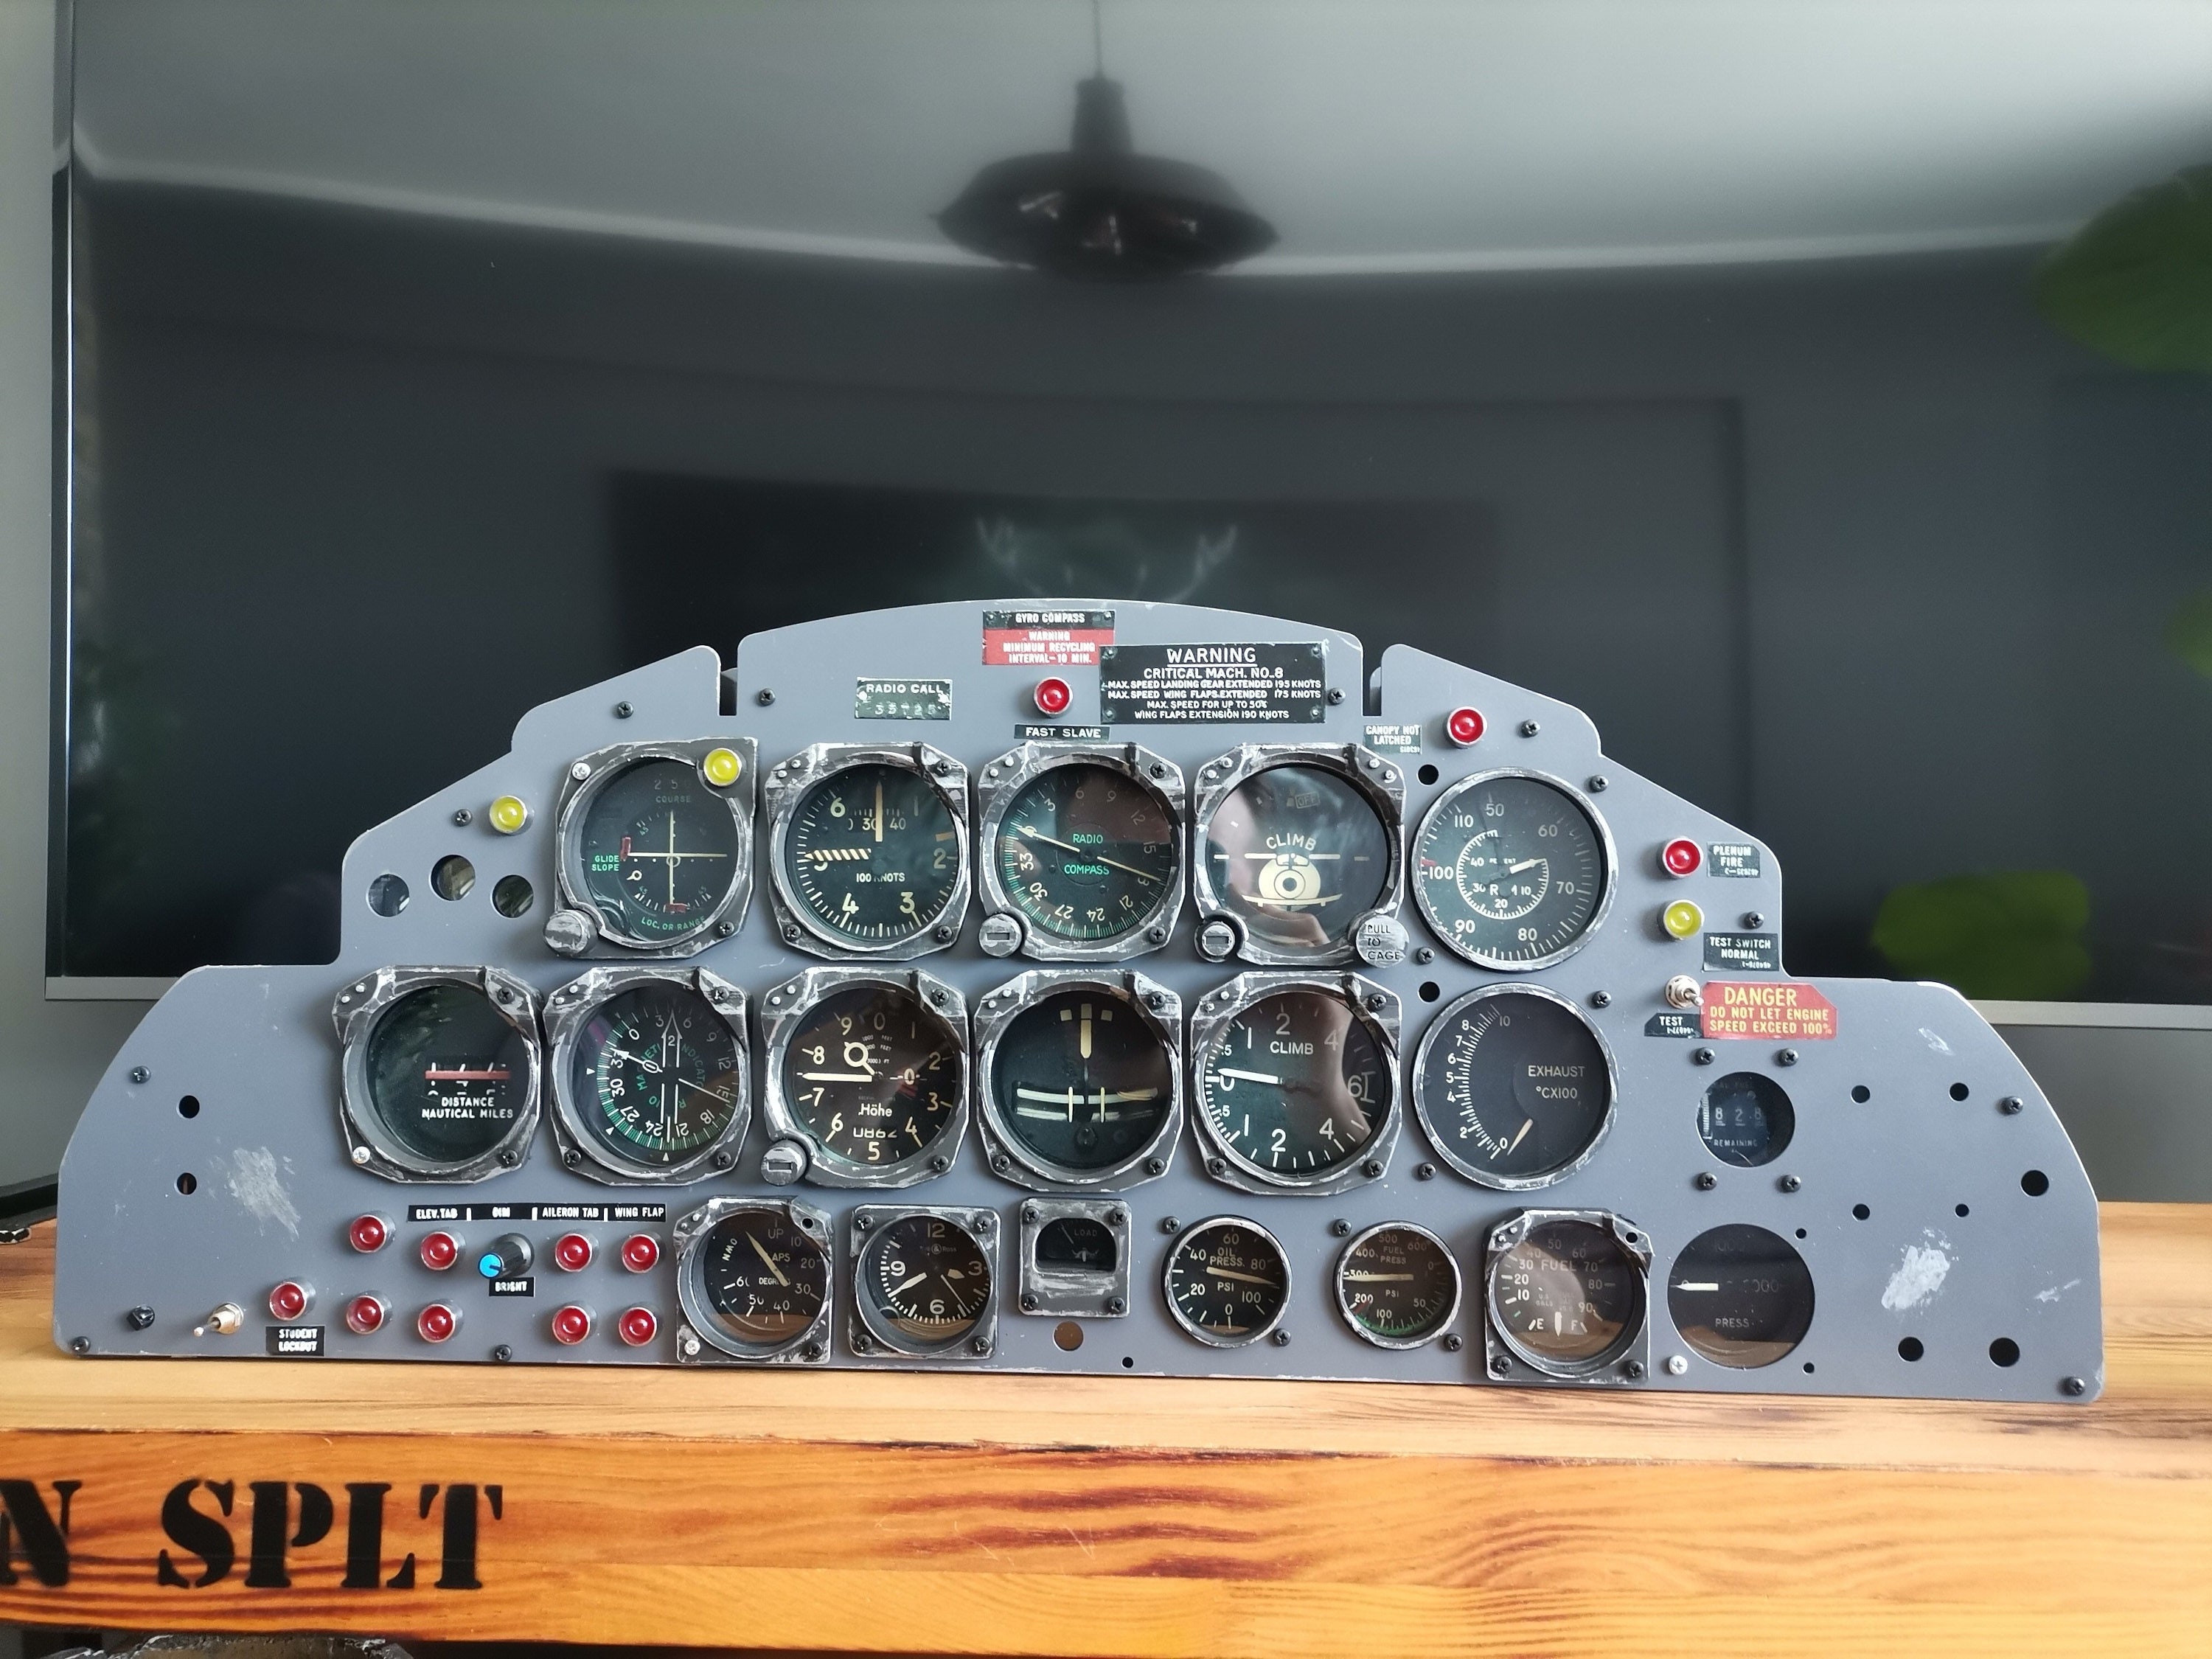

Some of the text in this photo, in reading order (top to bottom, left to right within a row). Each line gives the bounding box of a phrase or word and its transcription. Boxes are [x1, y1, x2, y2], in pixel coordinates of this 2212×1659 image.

[1015, 612, 1085, 623] GYRO COMPASS
[1029, 631, 1070, 641] WARNING
[1004, 642, 1095, 652] MINIMUM RECYCLING
[1071, 653, 1092, 663] MIN.
[1166, 647, 1256, 663] WARNING
[1144, 668, 1247, 678] CRITICAL MACH.
[866, 684, 943, 694] RADIO CALL
[1107, 679, 1321, 689] MAX. SPEED LANDING GEAR EXTENDED 195 KNOTS
[1107, 691, 1130, 699] MAX.
[1164, 690, 1186, 698] WING
[1274, 689, 1289, 698] 175
[1171, 700, 1199, 709] SPEED
[1135, 710, 1158, 718] WING
[1189, 709, 1239, 718] EXTENSION
[1259, 711, 1289, 719] KNOTS
[1026, 727, 1102, 737] FAST SLAVE
[1366, 725, 1419, 735] CANOPY NOT
[1374, 735, 1411, 745] LATCHED
[830, 797, 846, 818] 6
[1486, 804, 1504, 816] 50
[890, 818, 906, 830] 40
[1454, 815, 1473, 828] 110
[1538, 824, 1557, 837] 60
[1073, 833, 1103, 844] RADIO
[1266, 832, 1316, 851] CLIMB
[1714, 845, 1751, 856] PLENUM
[933, 848, 947, 869] 2
[1019, 852, 1034, 872] 33
[1470, 857, 1484, 866] 40
[1720, 857, 1743, 867] FIRE
[1065, 865, 1110, 875] COMPASS
[1429, 866, 1453, 879] 100
[856, 873, 872, 882] 100
[1029, 882, 1048, 902] 30
[1520, 886, 1531, 895] 10
[1557, 881, 1574, 894] 70
[842, 893, 859, 914] 4
[900, 892, 915, 914] 3
[1495, 899, 1508, 908] 20
[1054, 904, 1074, 919] 27
[1087, 908, 1105, 921] 24
[641, 917, 660, 930] LOC.
[1367, 924, 1391, 934] PULL
[1455, 919, 1475, 933] 90
[1518, 928, 1537, 941] 80
[1367, 938, 1380, 947] TO
[1709, 936, 1770, 949] TEST SWITCH
[1367, 951, 1400, 960] CAGE
[1721, 949, 1759, 960] NORMAL
[1724, 986, 1797, 1006] DANGER
[1710, 1006, 1829, 1020] DO NOT LET ENGINE
[1276, 1013, 1290, 1034] 2
[1462, 1020, 1470, 1030] 8
[1500, 1015, 1510, 1026] 10
[1659, 1016, 1683, 1026] TEST
[841, 1018, 852, 1035] 9
[1710, 1020, 1796, 1033] SPEED EXCEED
[1324, 1032, 1338, 1051] 4
[1270, 1040, 1313, 1055] CLIMB
[813, 1046, 825, 1065] 8
[928, 1051, 940, 1070] 2
[1447, 1053, 1456, 1064] 6
[1528, 1065, 1585, 1077] EXHAUST
[611, 1079, 625, 1098] 30
[1348, 1075, 1362, 1097] 6
[442, 1097, 494, 1107] DISTANCE
[813, 1088, 824, 1107] 7
[927, 1092, 939, 1111] 3
[422, 1109, 513, 1119] NAUTICAL MILES
[619, 1106, 640, 1122] 27
[860, 1103, 893, 1117] Höhe
[831, 1113, 844, 1132] 6
[1319, 1118, 1334, 1140] 4
[1271, 1129, 1287, 1152] 2
[868, 1141, 880, 1161] 5
[542, 1207, 599, 1217] AILERON TAB
[615, 1207, 664, 1217] WING FLAP
[768, 1229, 784, 1239] UP
[928, 1222, 945, 1238] 12
[791, 1237, 801, 1247] 10
[1223, 1234, 1239, 1245] 60
[1379, 1234, 1397, 1243] 500
[1190, 1249, 1206, 1261] 40
[1217, 1248, 1235, 1256] OIL
[1356, 1248, 1375, 1257] 400
[1383, 1246, 1404, 1254] FUEL
[801, 1258, 815, 1269] 20
[1210, 1256, 1245, 1267] PRESS.
[1251, 1259, 1265, 1270] 80
[1519, 1259, 1533, 1269] 30
[1541, 1260, 1577, 1271] FUEL
[1585, 1262, 1598, 1272] 70
[890, 1260, 905, 1276] 9
[968, 1261, 982, 1276] 3
[1514, 1274, 1528, 1285] 20
[1588, 1279, 1602, 1290] 80
[495, 1281, 527, 1292] BRIGHT
[795, 1284, 811, 1294] 30
[1191, 1283, 1206, 1295] 20
[1217, 1282, 1234, 1291] PSI
[1242, 1291, 1261, 1304] 100
[1517, 1290, 1529, 1301] 10
[773, 1300, 790, 1311] 40
[930, 1299, 945, 1315] 6
[1413, 1299, 1426, 1307] 50
[1579, 1303, 1593, 1312] 90
[1225, 1304, 1232, 1315] 0
[1377, 1310, 1392, 1318] 100
[1537, 1318, 1544, 1329] E
[1571, 1320, 1578, 1331] F
[1715, 1318, 1749, 1327] PRESS
[279, 1329, 317, 1339] STUDENT
[279, 1341, 317, 1352] LOCKOUT
[157, 1478, 503, 1590] SPLT
